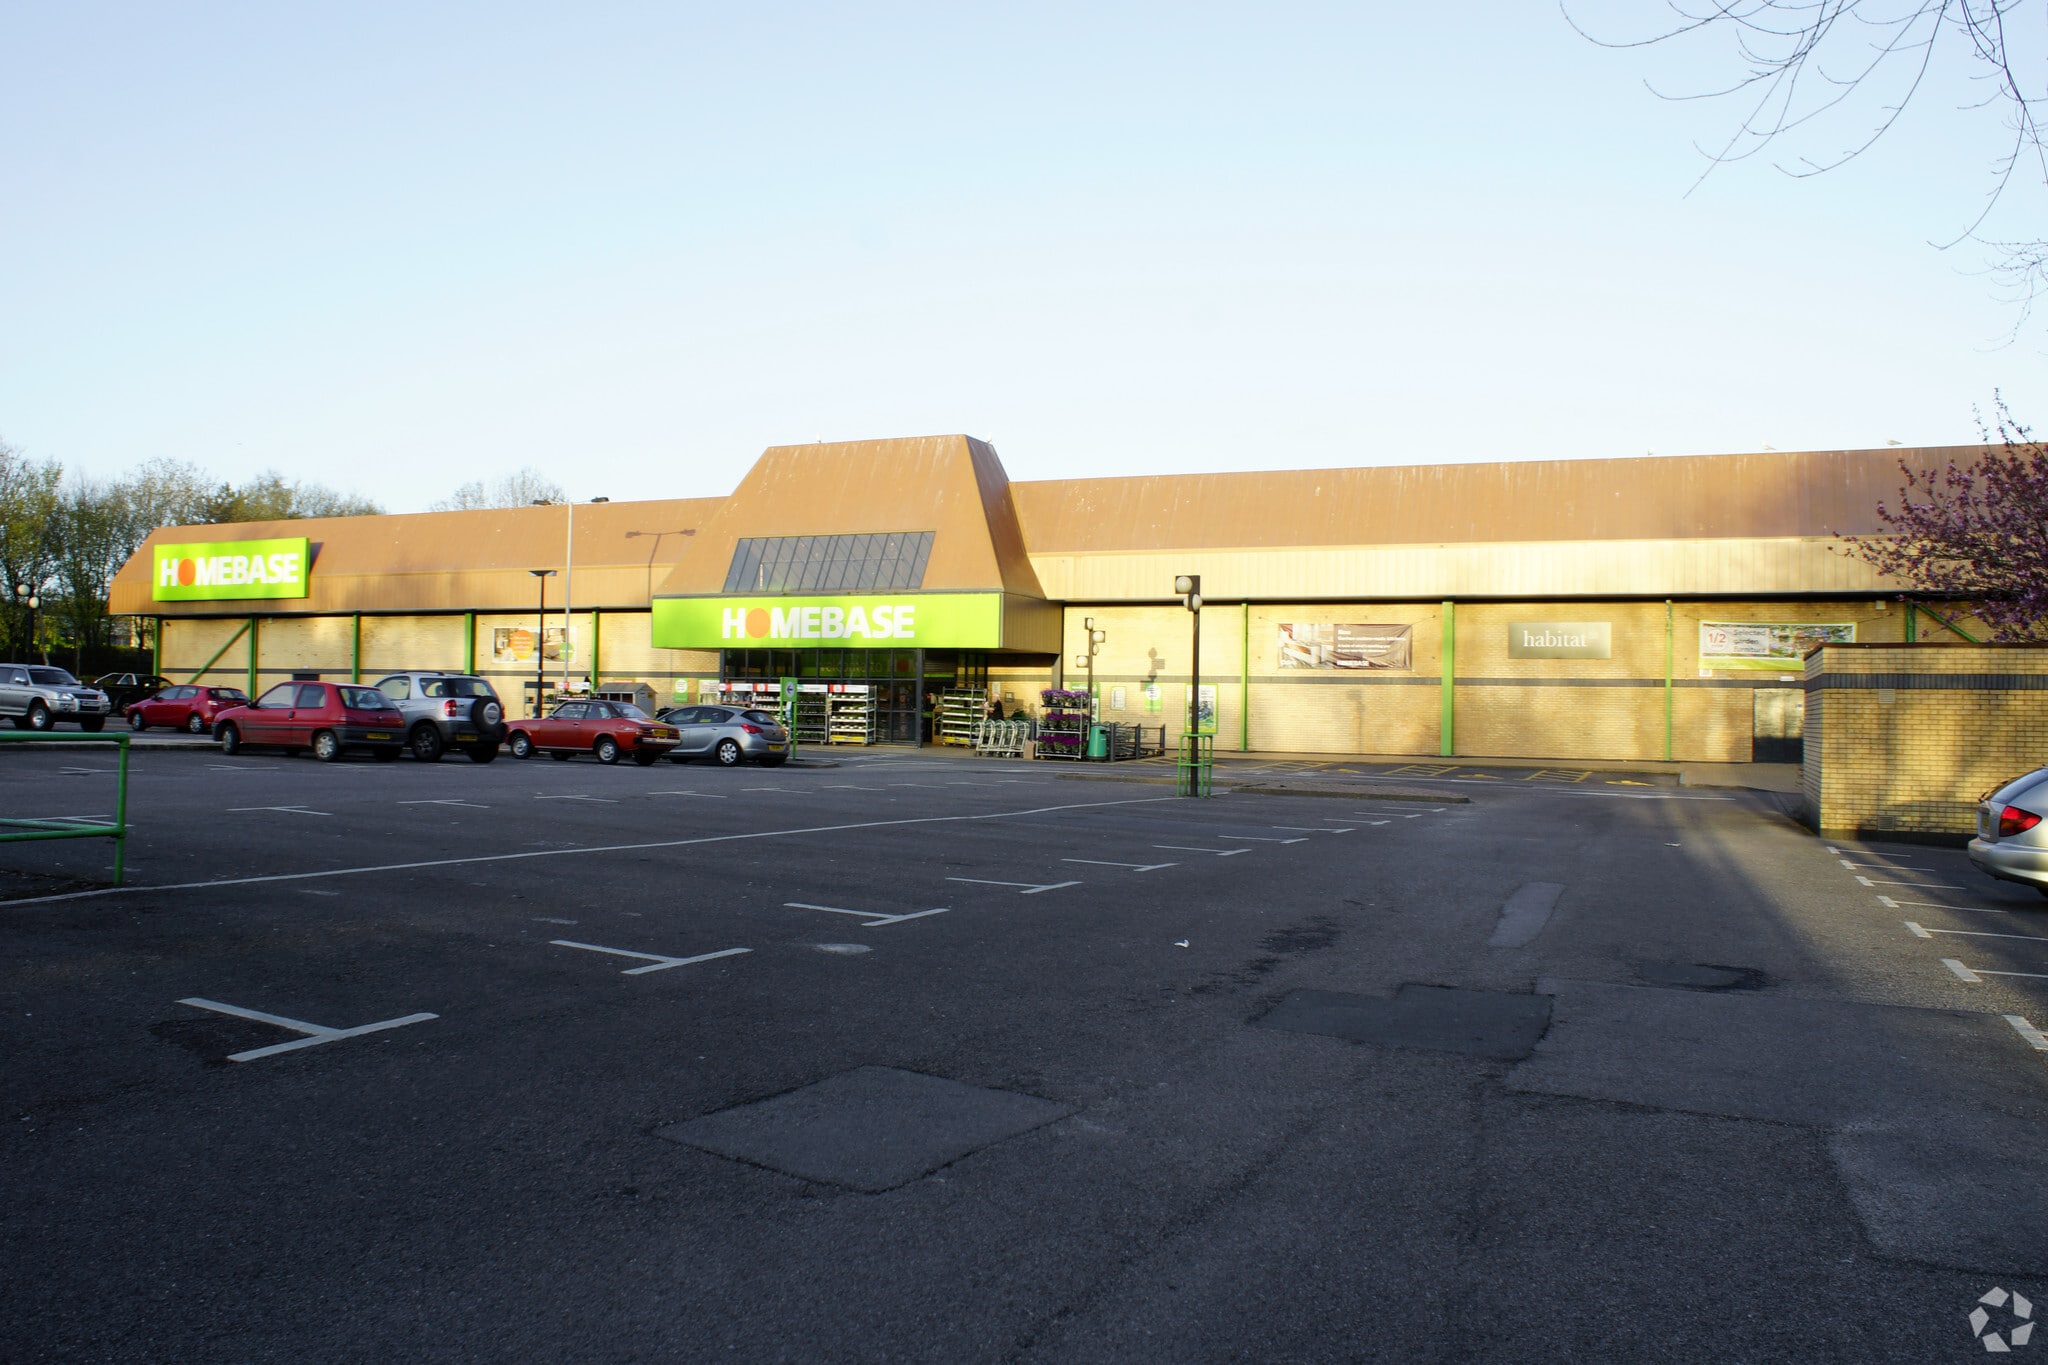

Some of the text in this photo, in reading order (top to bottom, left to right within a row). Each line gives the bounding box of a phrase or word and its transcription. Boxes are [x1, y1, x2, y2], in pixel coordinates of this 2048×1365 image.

[160, 553, 299, 587] HOMEBASE
[722, 605, 915, 639] HOMEBASE
[1523, 630, 1588, 648] habitat
